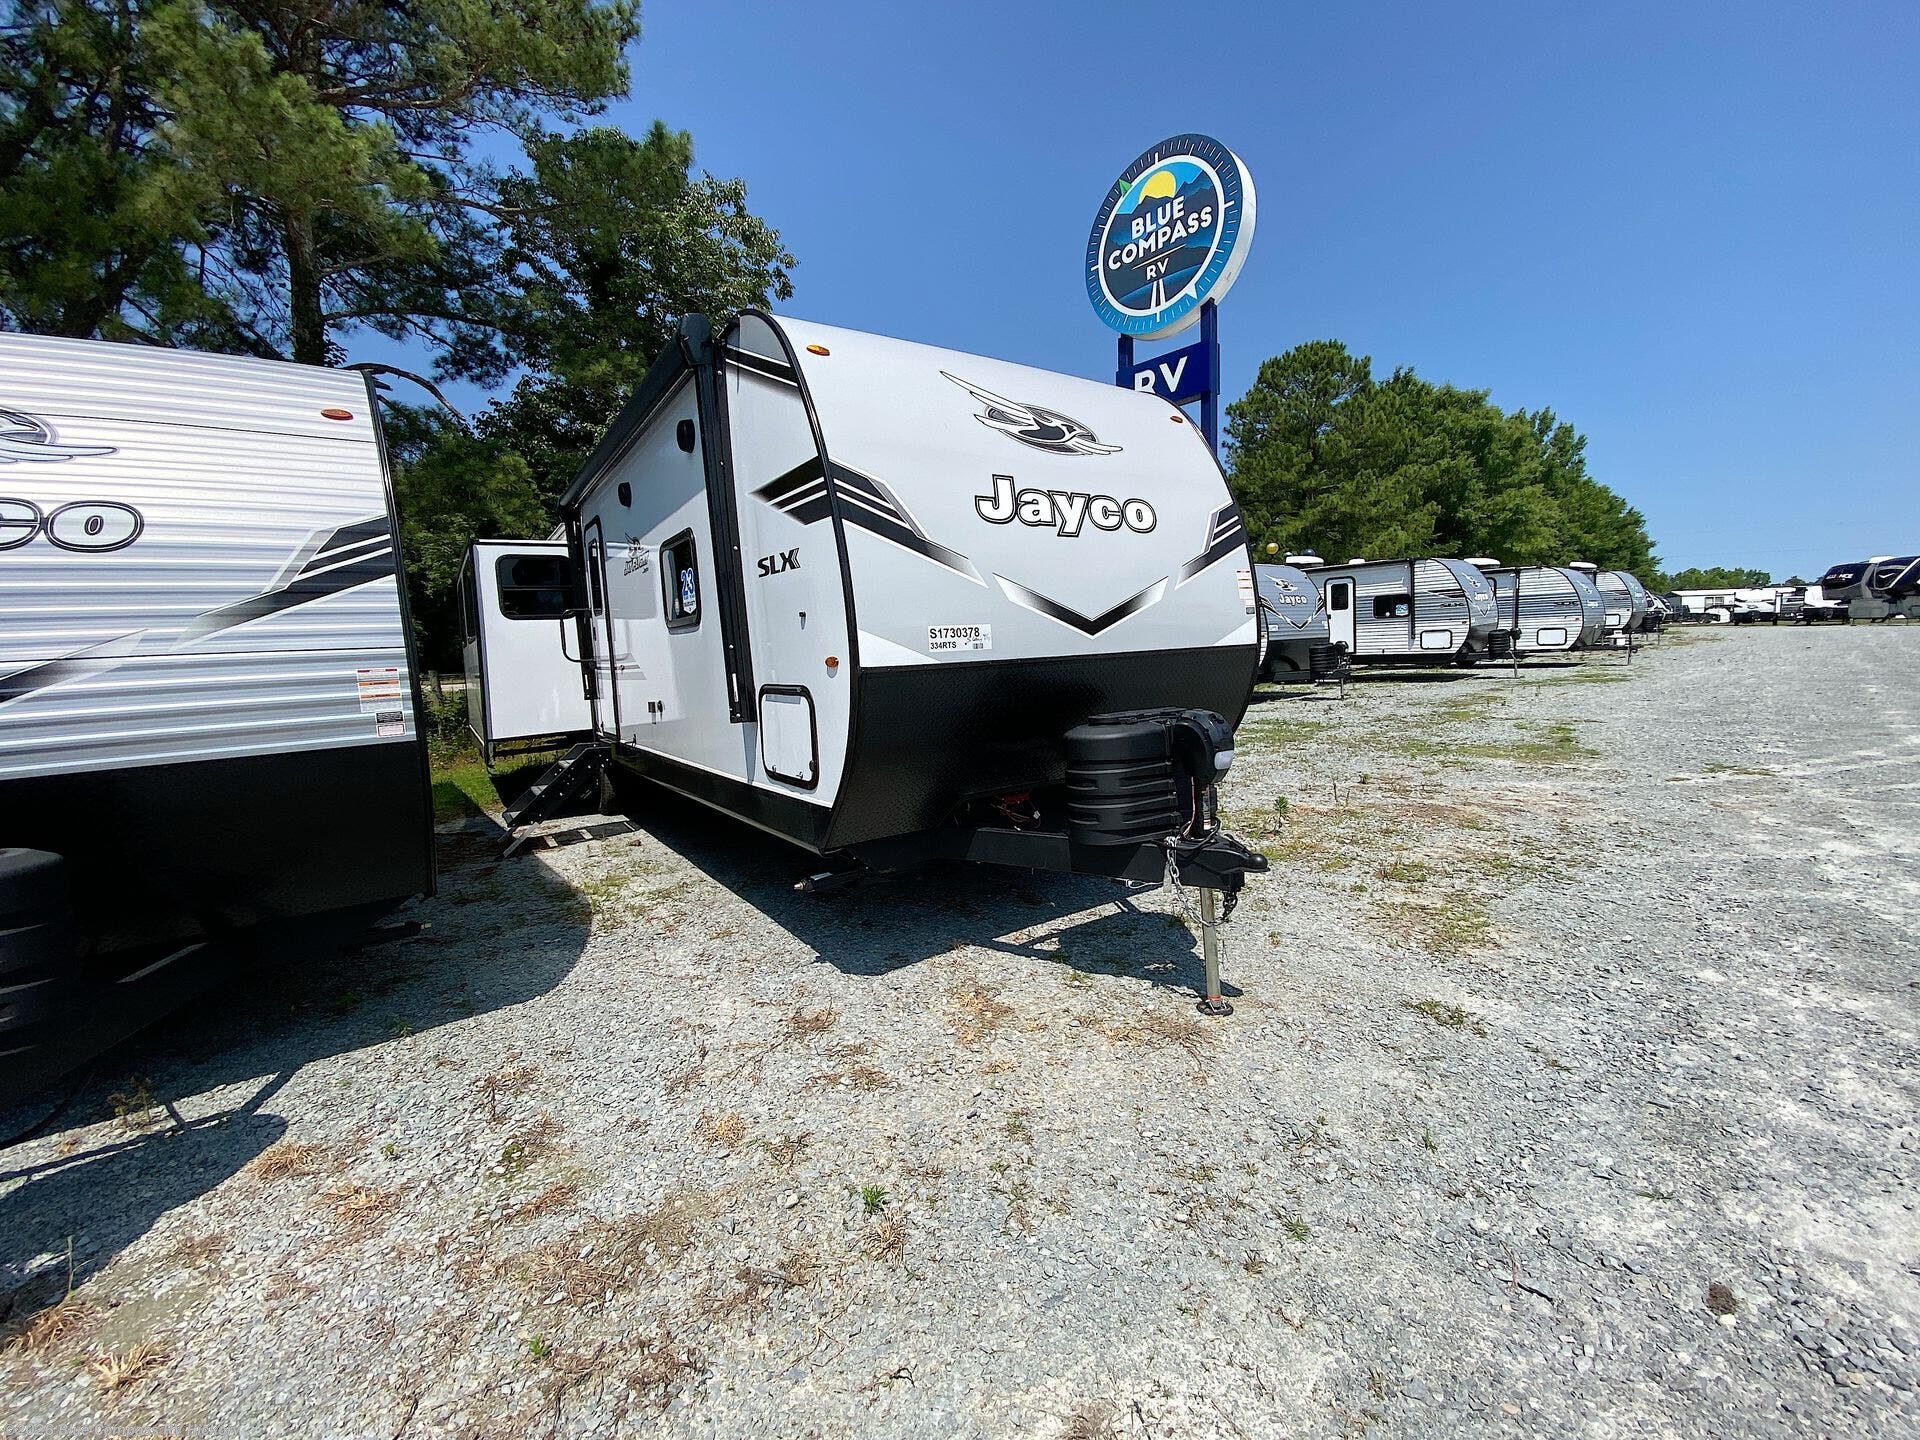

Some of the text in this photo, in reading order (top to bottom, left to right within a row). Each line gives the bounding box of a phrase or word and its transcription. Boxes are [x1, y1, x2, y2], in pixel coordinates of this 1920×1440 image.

[1131, 195, 1185, 240] BLUE
[1108, 206, 1212, 270] COMPASS
[1146, 257, 1169, 280] RV
[1134, 356, 1188, 394] RV
[975, 474, 1157, 537] Jayco
[757, 547, 801, 578] SLX
[681, 567, 695, 596] 23
[1278, 593, 1308, 606] Jayco
[930, 627, 980, 639] S1730378
[930, 641, 957, 650] 334RTS
